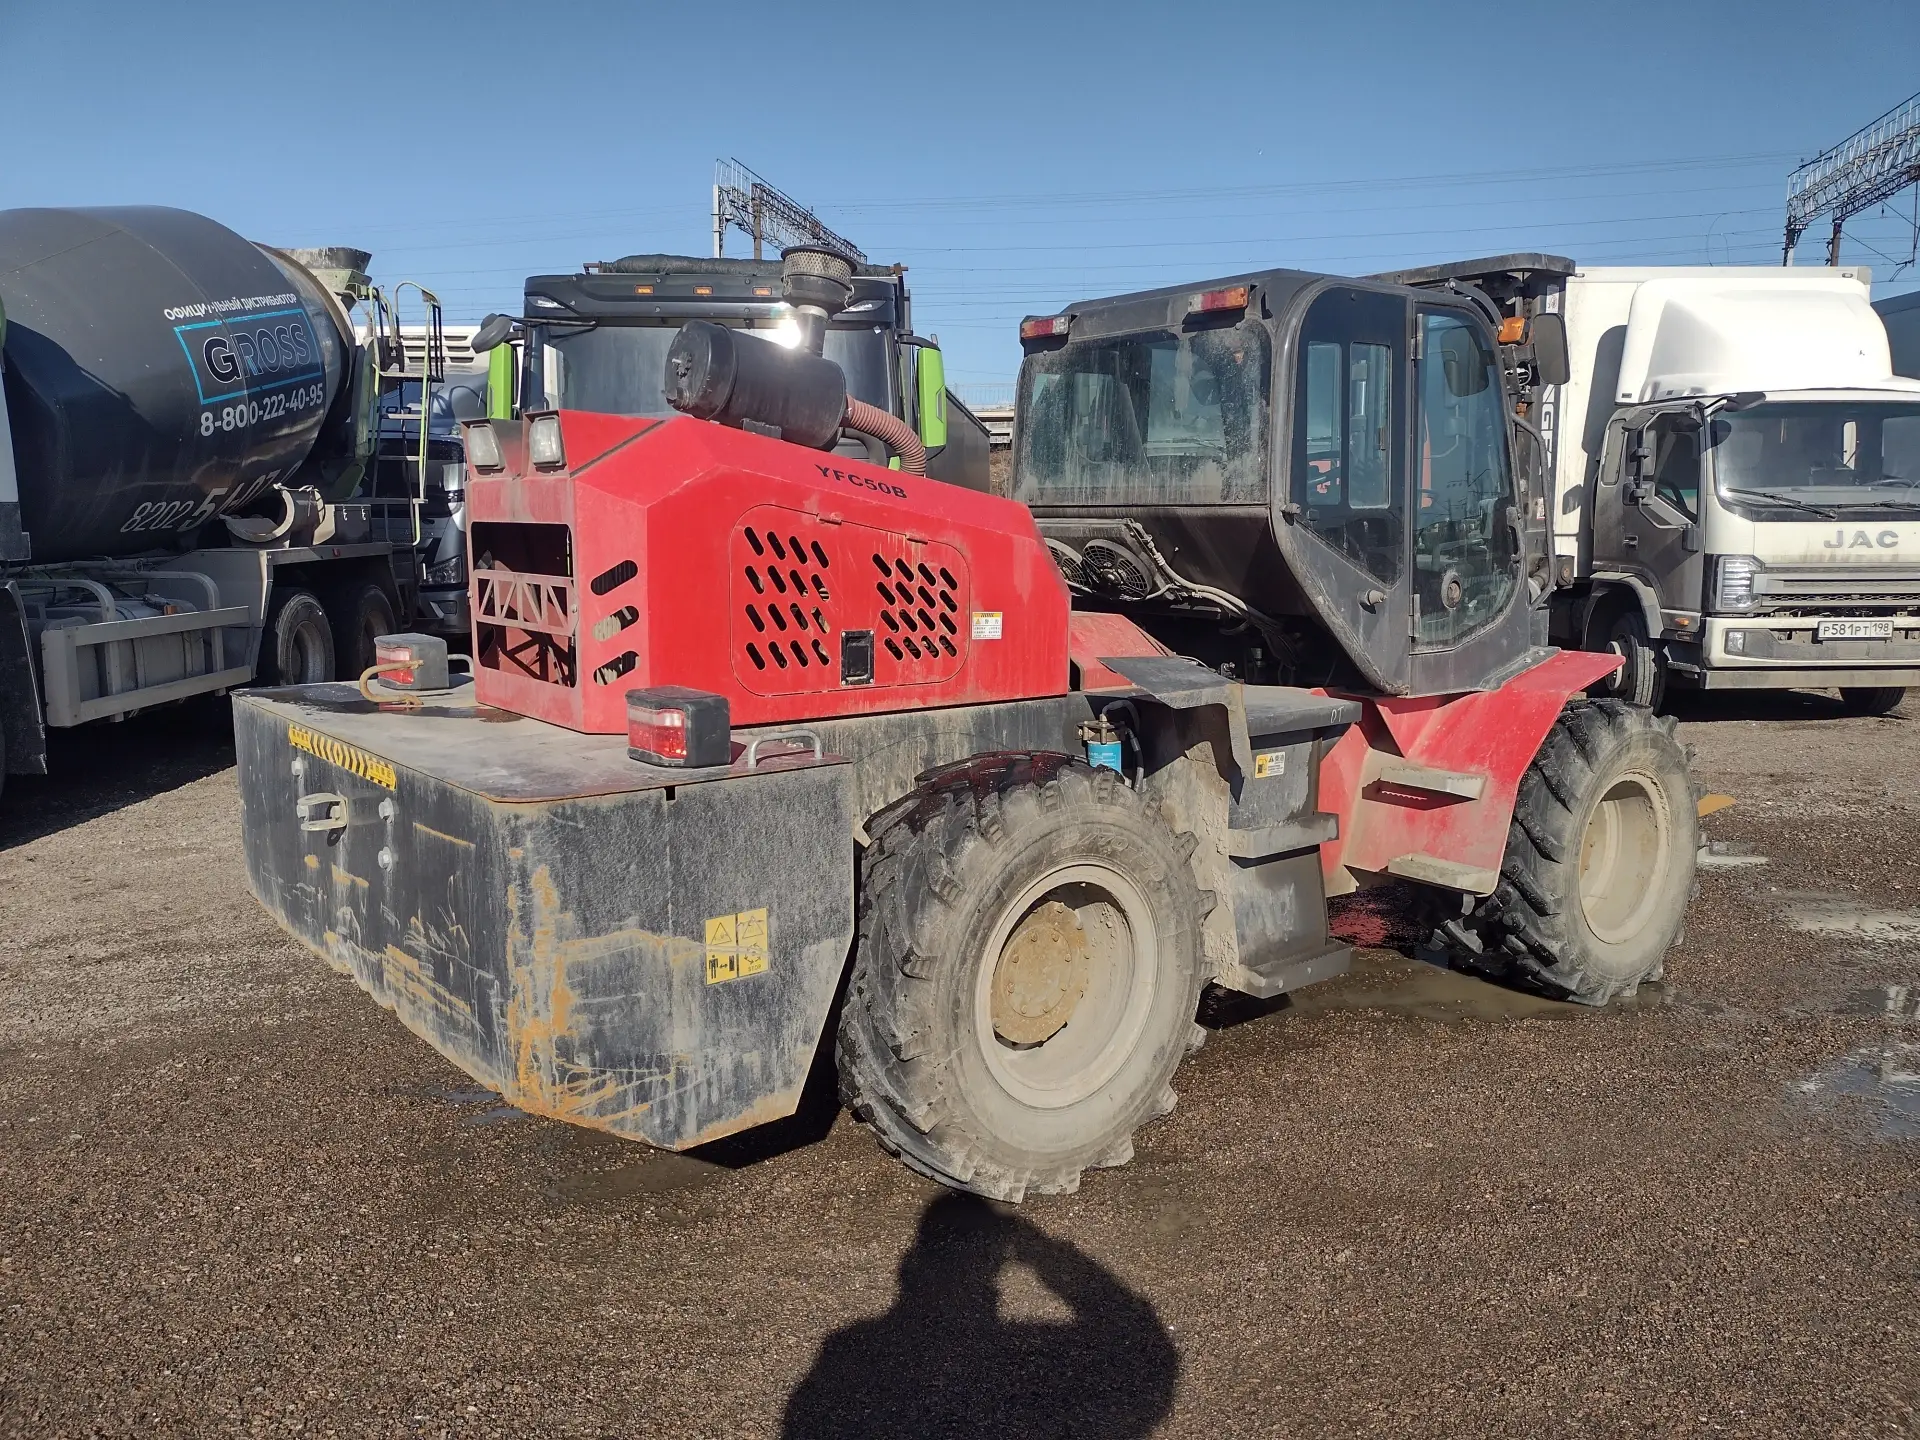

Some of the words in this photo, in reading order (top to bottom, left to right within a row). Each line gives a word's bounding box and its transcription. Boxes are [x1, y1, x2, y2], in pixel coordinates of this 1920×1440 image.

[241, 293, 297, 310] ДИСТРИБЬЮТОР
[203, 323, 311, 384] GROSS
[200, 383, 323, 437] 8-800-222-40-95
[814, 464, 907, 499] YFC50B
[120, 501, 194, 533] 8202
[1823, 530, 1899, 549] JAC
[1872, 623, 1890, 633] 198
